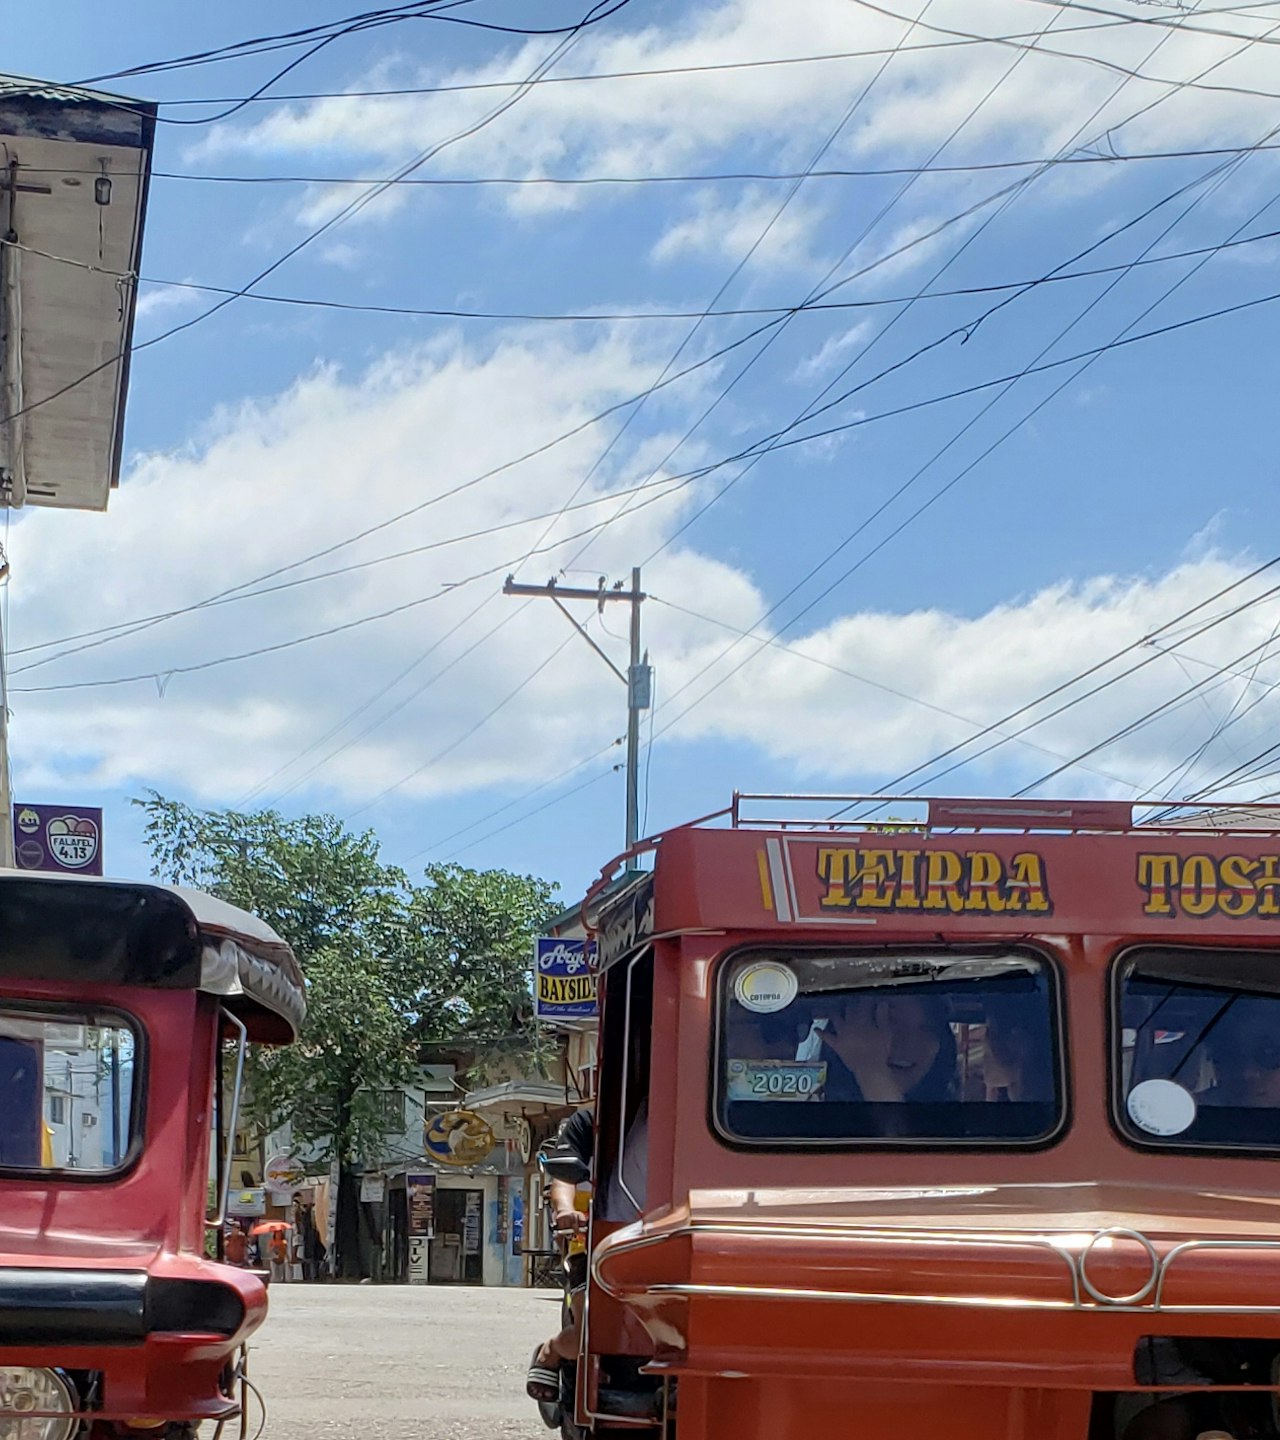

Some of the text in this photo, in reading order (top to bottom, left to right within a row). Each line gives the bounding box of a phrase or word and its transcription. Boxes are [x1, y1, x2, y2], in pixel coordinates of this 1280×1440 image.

[53, 838, 93, 847] FALAFEL
[59, 846, 87, 859] 4.13
[817, 848, 1052, 916] TEIRRA
[752, 1073, 812, 1093] 2020
